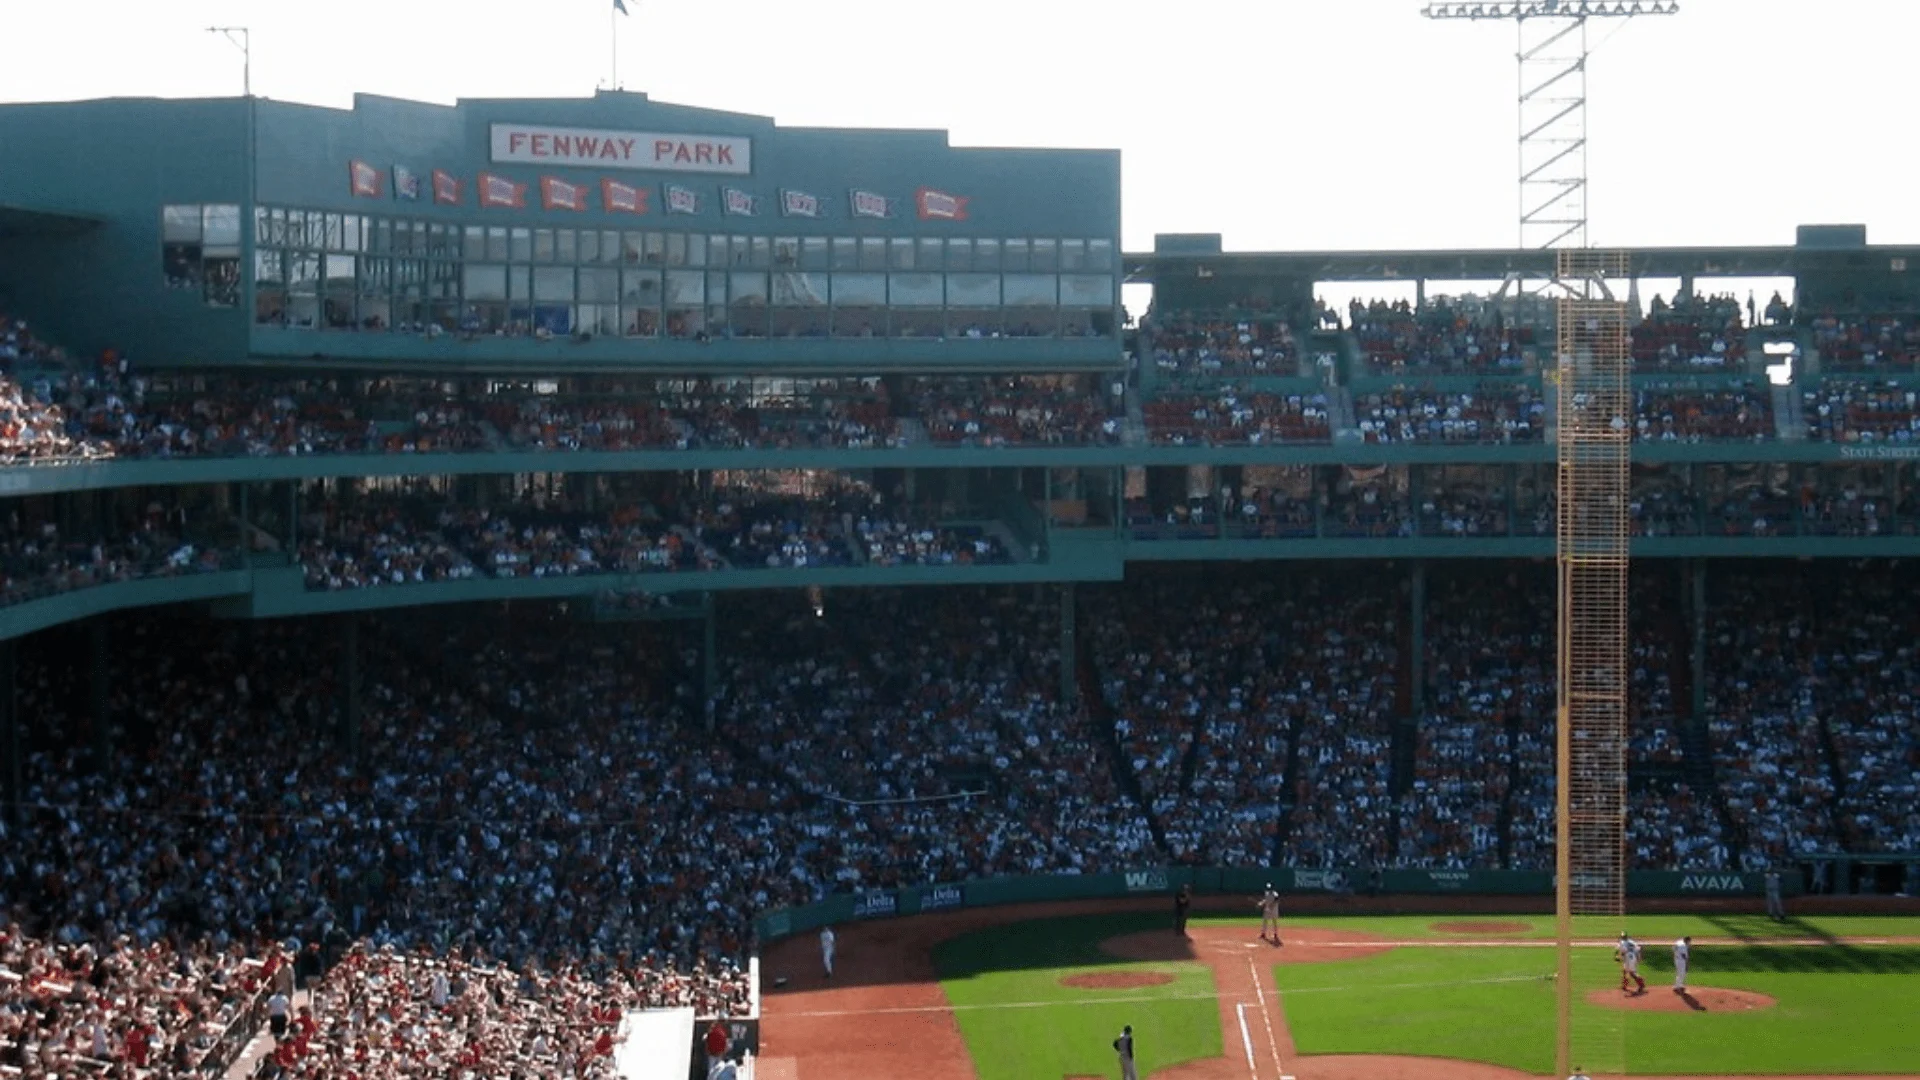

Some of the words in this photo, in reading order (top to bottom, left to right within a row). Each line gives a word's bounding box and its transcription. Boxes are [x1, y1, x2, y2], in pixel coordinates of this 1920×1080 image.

[509, 132, 636, 160] FENWAY
[654, 140, 734, 165] PARK
[1680, 875, 1745, 890] AVAYA
